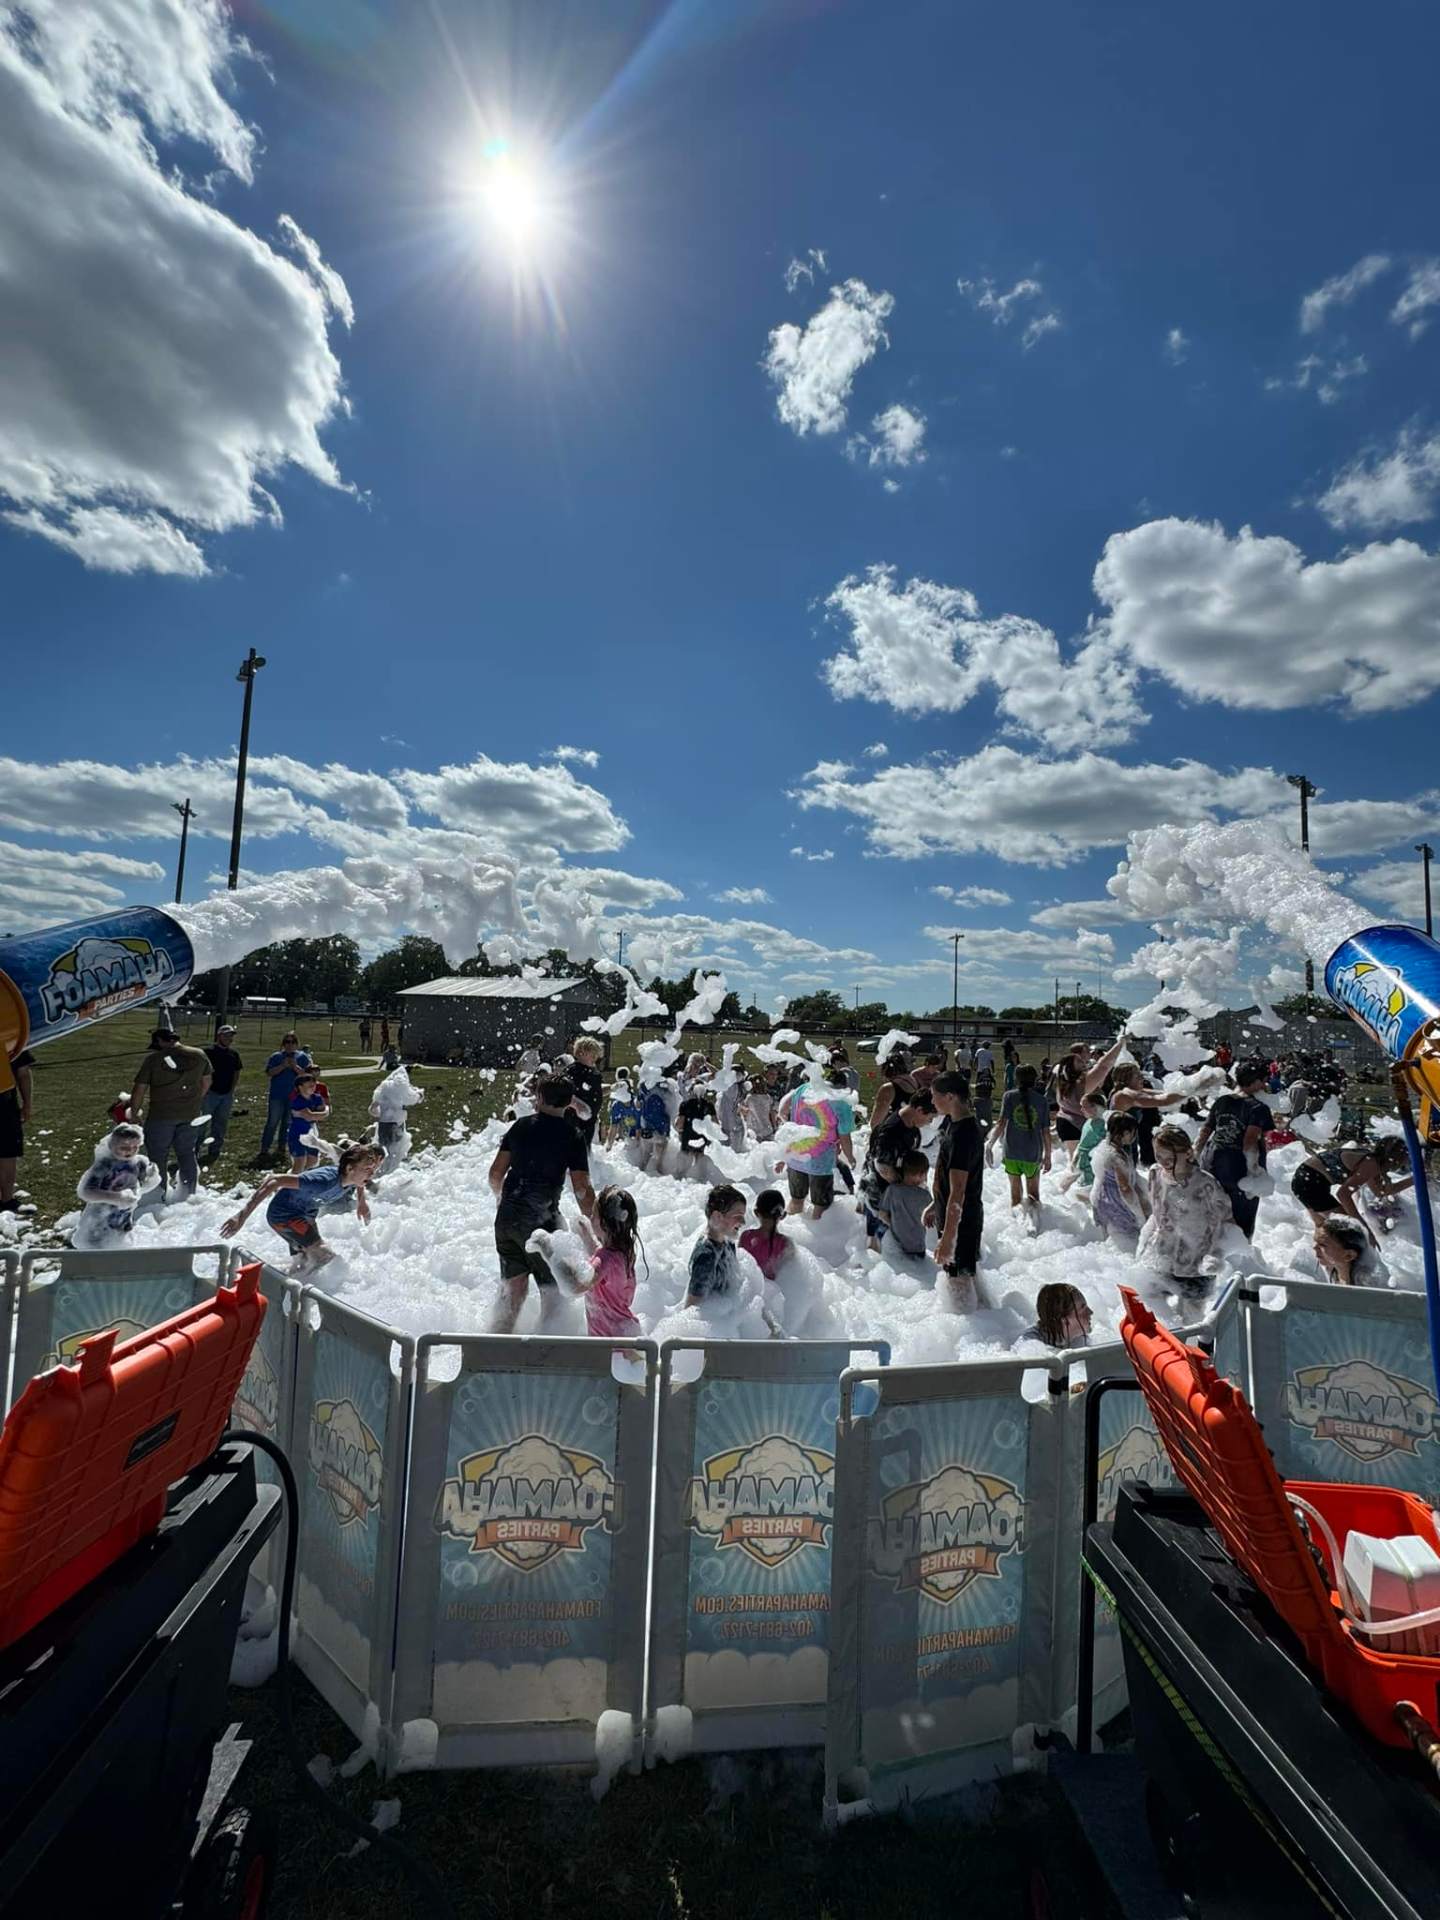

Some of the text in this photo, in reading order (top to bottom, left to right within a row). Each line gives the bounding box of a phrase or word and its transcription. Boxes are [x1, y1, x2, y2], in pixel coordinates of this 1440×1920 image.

[41, 949, 172, 1023] FOAMAHA
[94, 987, 136, 1011] PARTIES
[1335, 968, 1400, 1060] FOAMAHA
